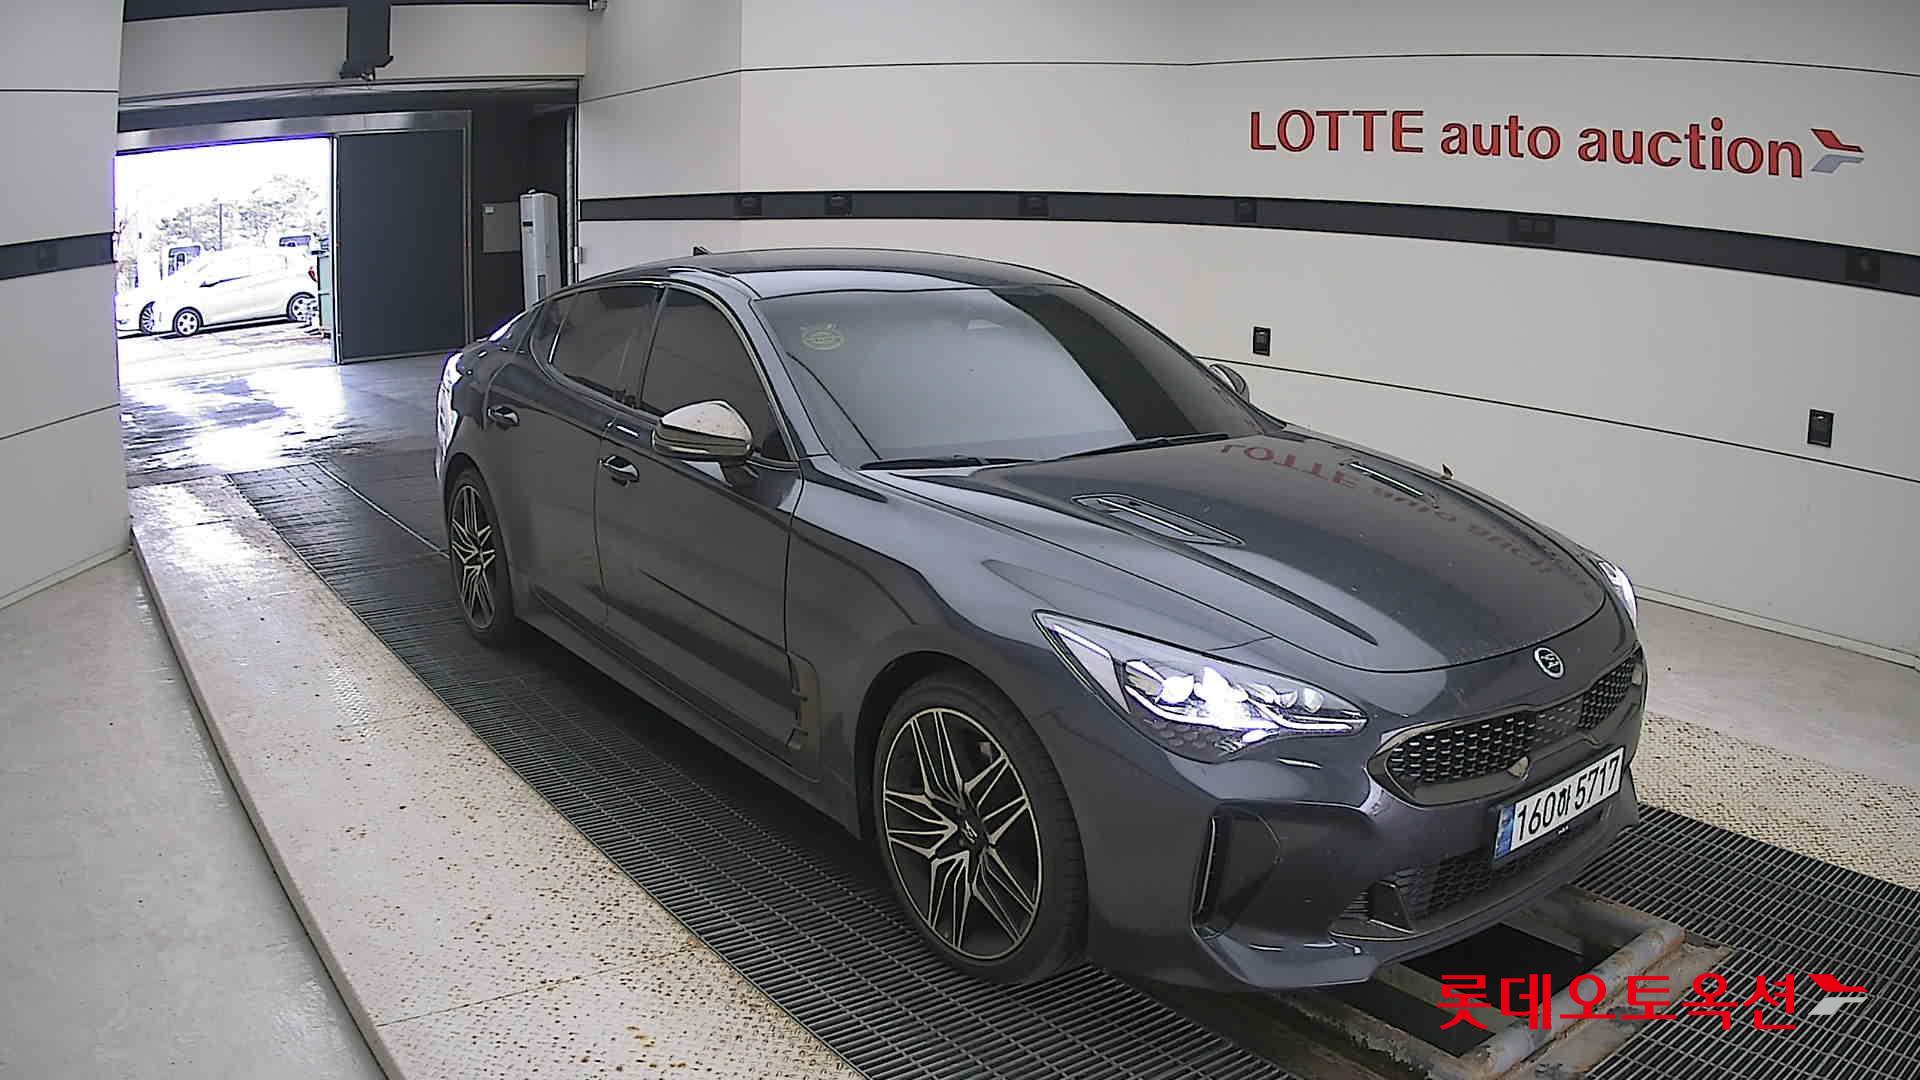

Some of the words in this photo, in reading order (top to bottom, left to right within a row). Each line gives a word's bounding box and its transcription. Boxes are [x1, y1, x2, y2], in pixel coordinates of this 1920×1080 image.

[1250, 110, 1423, 154] LOTTE
[1441, 115, 1562, 160] auto
[1577, 117, 1804, 178] auction
[1574, 755, 1620, 811] 5717
